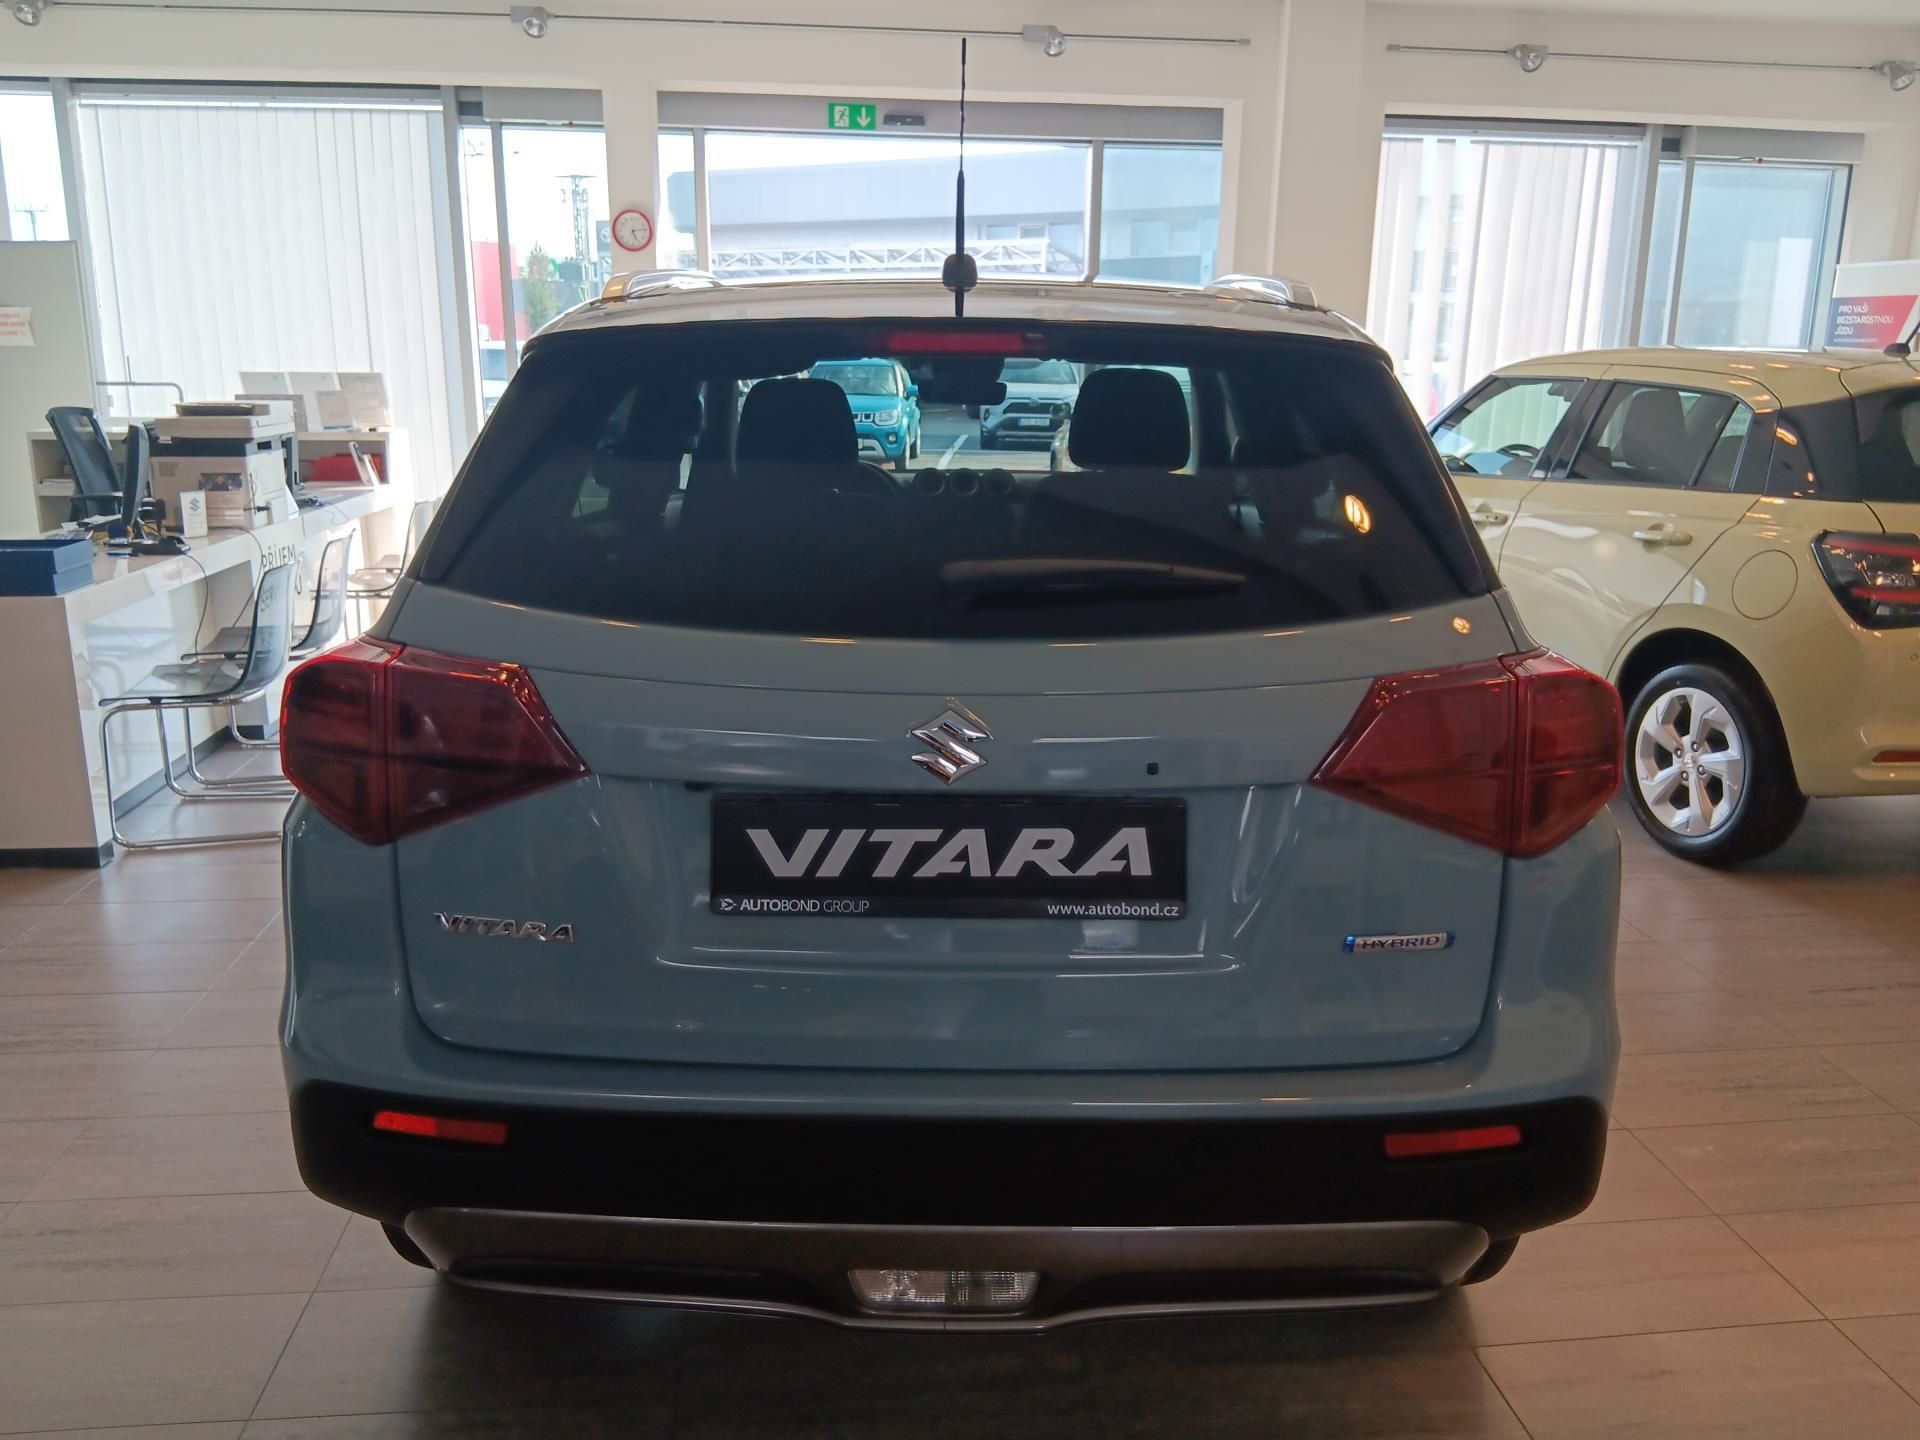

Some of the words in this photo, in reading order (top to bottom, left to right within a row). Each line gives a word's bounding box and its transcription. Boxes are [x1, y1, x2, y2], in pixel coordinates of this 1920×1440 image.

[1839, 305, 1852, 313] PRO
[745, 827, 1153, 878] VITARA
[739, 898, 821, 912] AUTOBOND
[823, 899, 870, 913] GROUP
[1047, 902, 1179, 917] www.autobond.cz
[432, 911, 574, 944] VITARA
[1361, 936, 1440, 949] HYBRID
